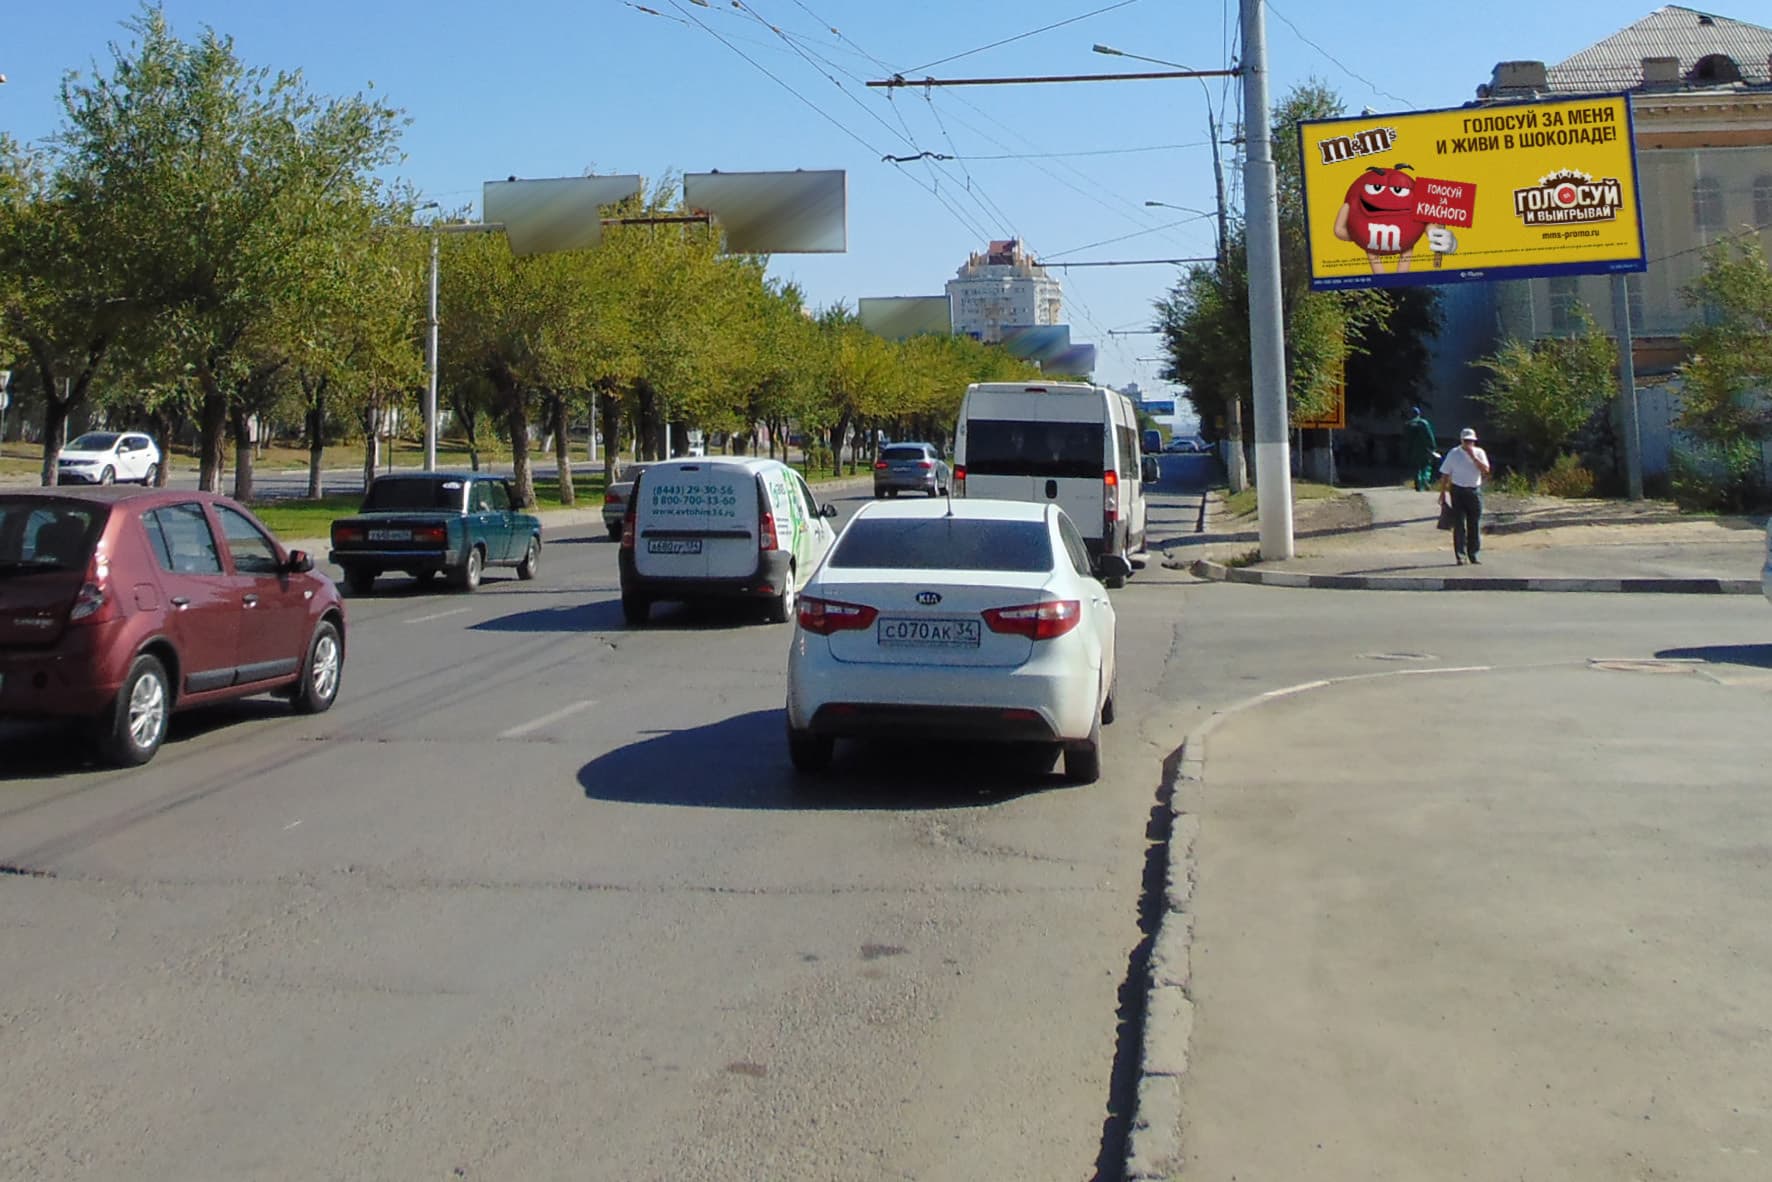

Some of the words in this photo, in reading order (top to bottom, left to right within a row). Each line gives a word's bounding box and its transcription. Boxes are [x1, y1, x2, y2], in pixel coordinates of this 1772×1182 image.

[1463, 110, 1537, 133] ГОЛОСУЙ
[1542, 111, 1564, 127] ЗА
[1568, 107, 1615, 125] МЕНЯ
[1436, 139, 1447, 155] И
[1451, 135, 1500, 153] ЖИВИ
[1504, 134, 1515, 149] В
[1519, 126, 1617, 148] ШОКОЛАДЕ!
[1427, 183, 1463, 199] ГОЛОСУЙ
[1517, 180, 1619, 212] ГОЛОСУЙ
[1416, 202, 1467, 221] КРАСНОГО
[1527, 211, 1535, 222] И
[1537, 205, 1611, 221] ВЫИГРЫВАЙ
[1542, 229, 1600, 241] mms-promo.ru
[918, 593, 938, 604] KIA
[957, 623, 973, 636] 34
